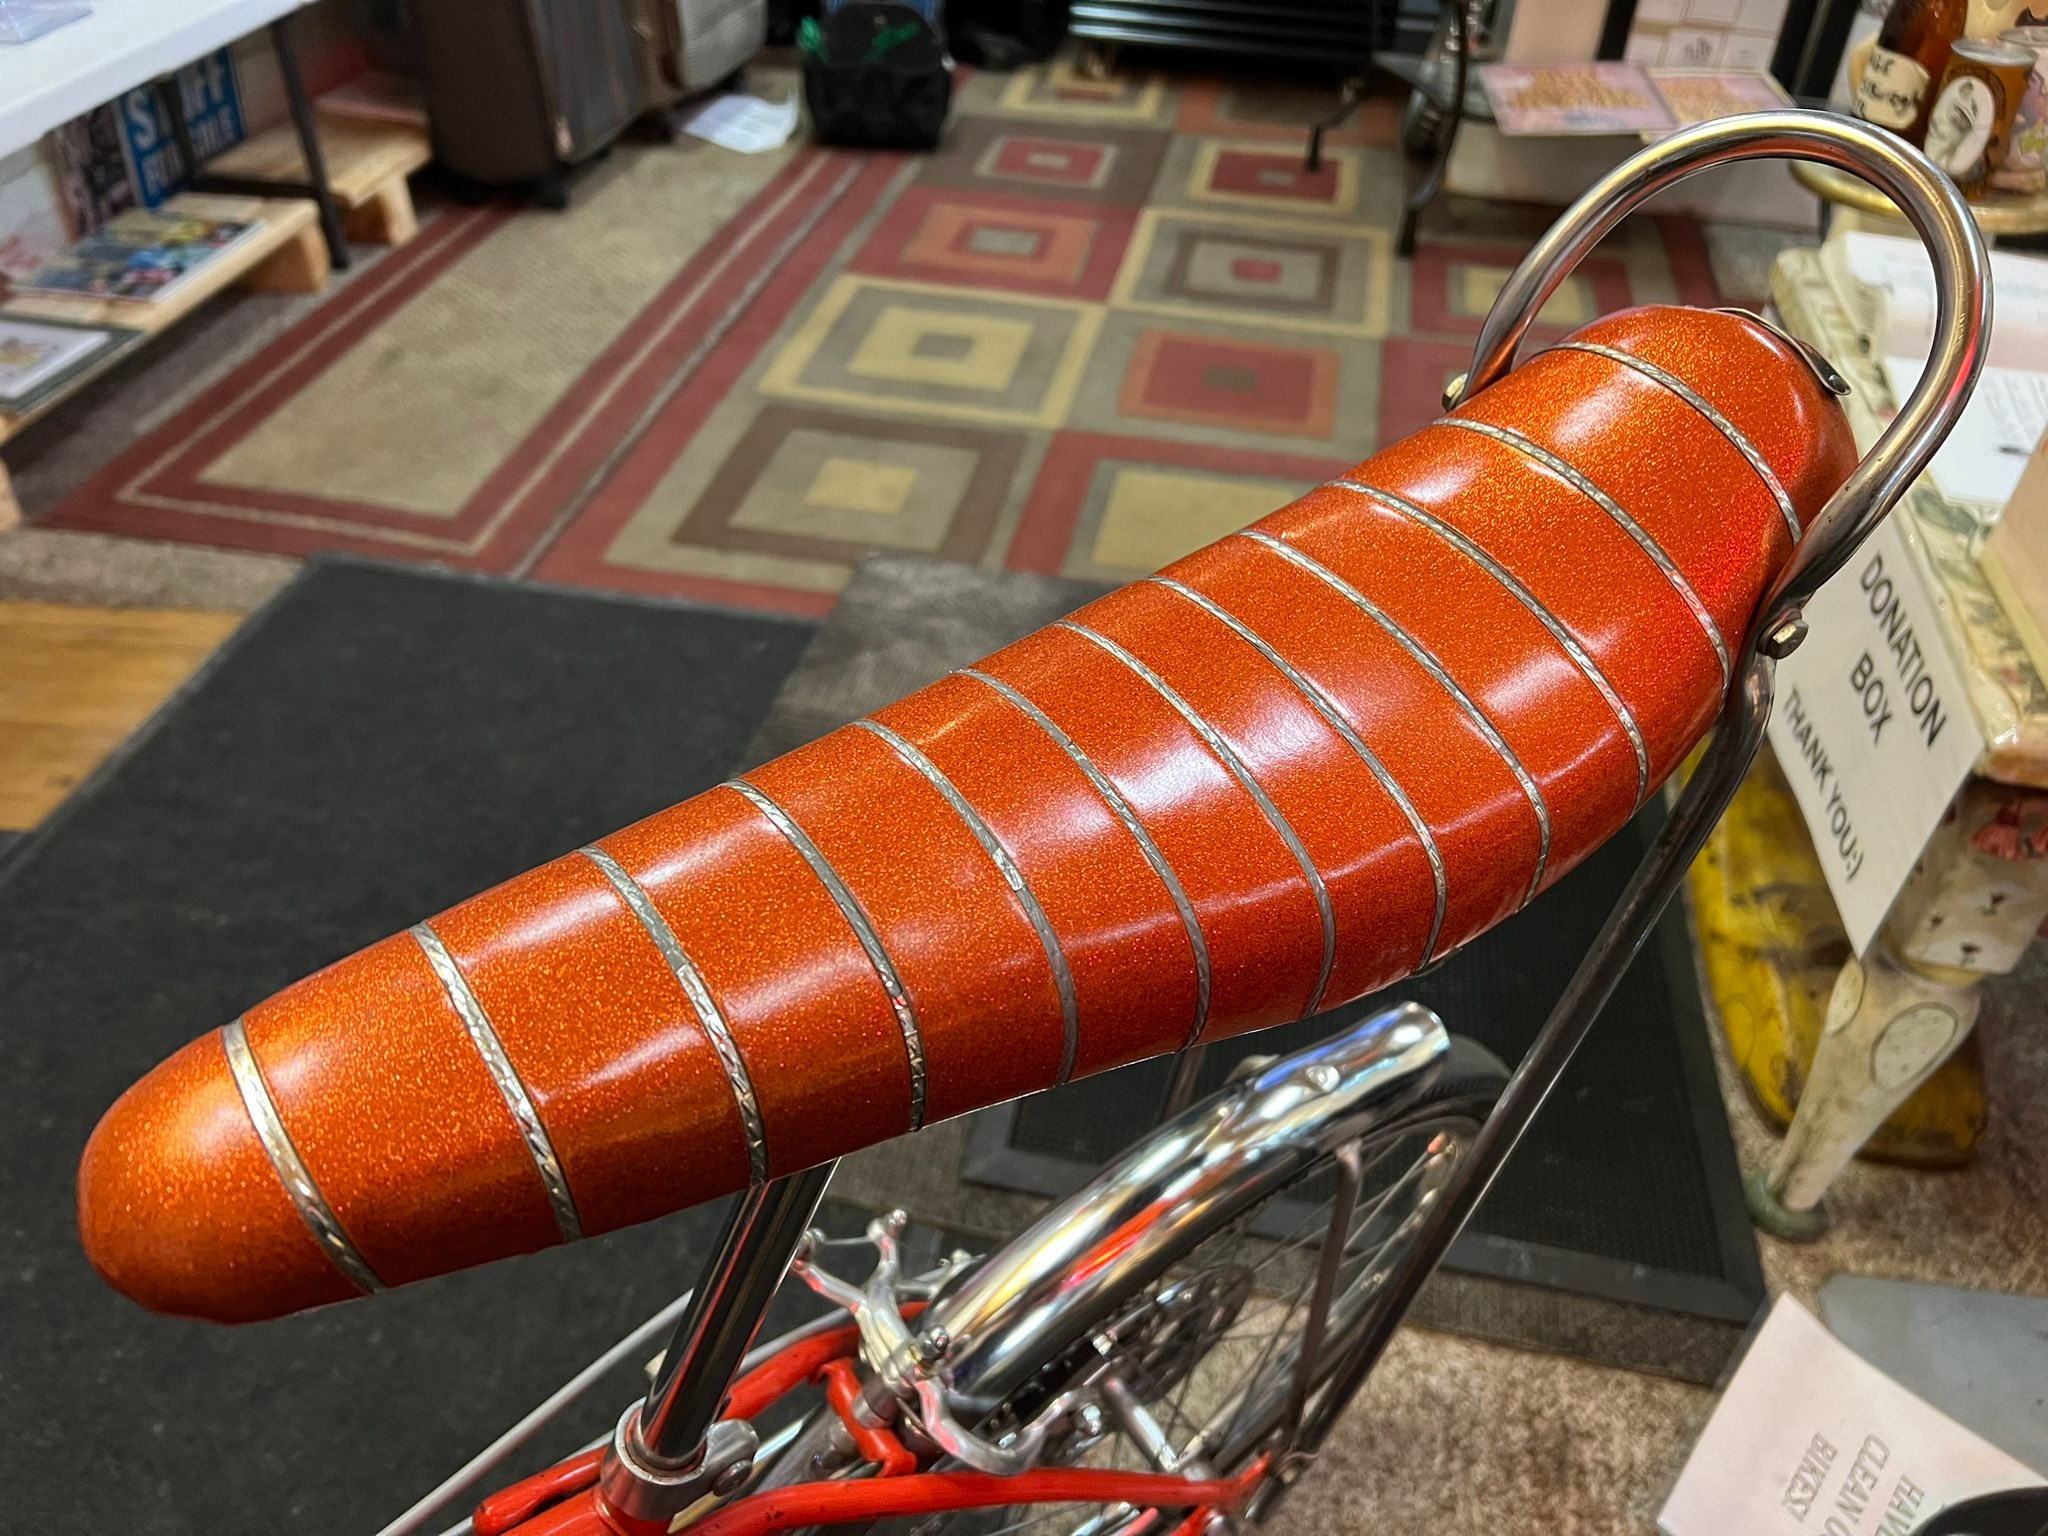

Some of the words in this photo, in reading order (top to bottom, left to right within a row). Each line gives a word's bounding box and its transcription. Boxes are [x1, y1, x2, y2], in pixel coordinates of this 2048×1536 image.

[1851, 652, 1892, 744] BOX
[1861, 553, 1946, 748] DONATION
[1784, 684, 1834, 794] THANK
[1836, 1434, 1890, 1524] CLEAN
